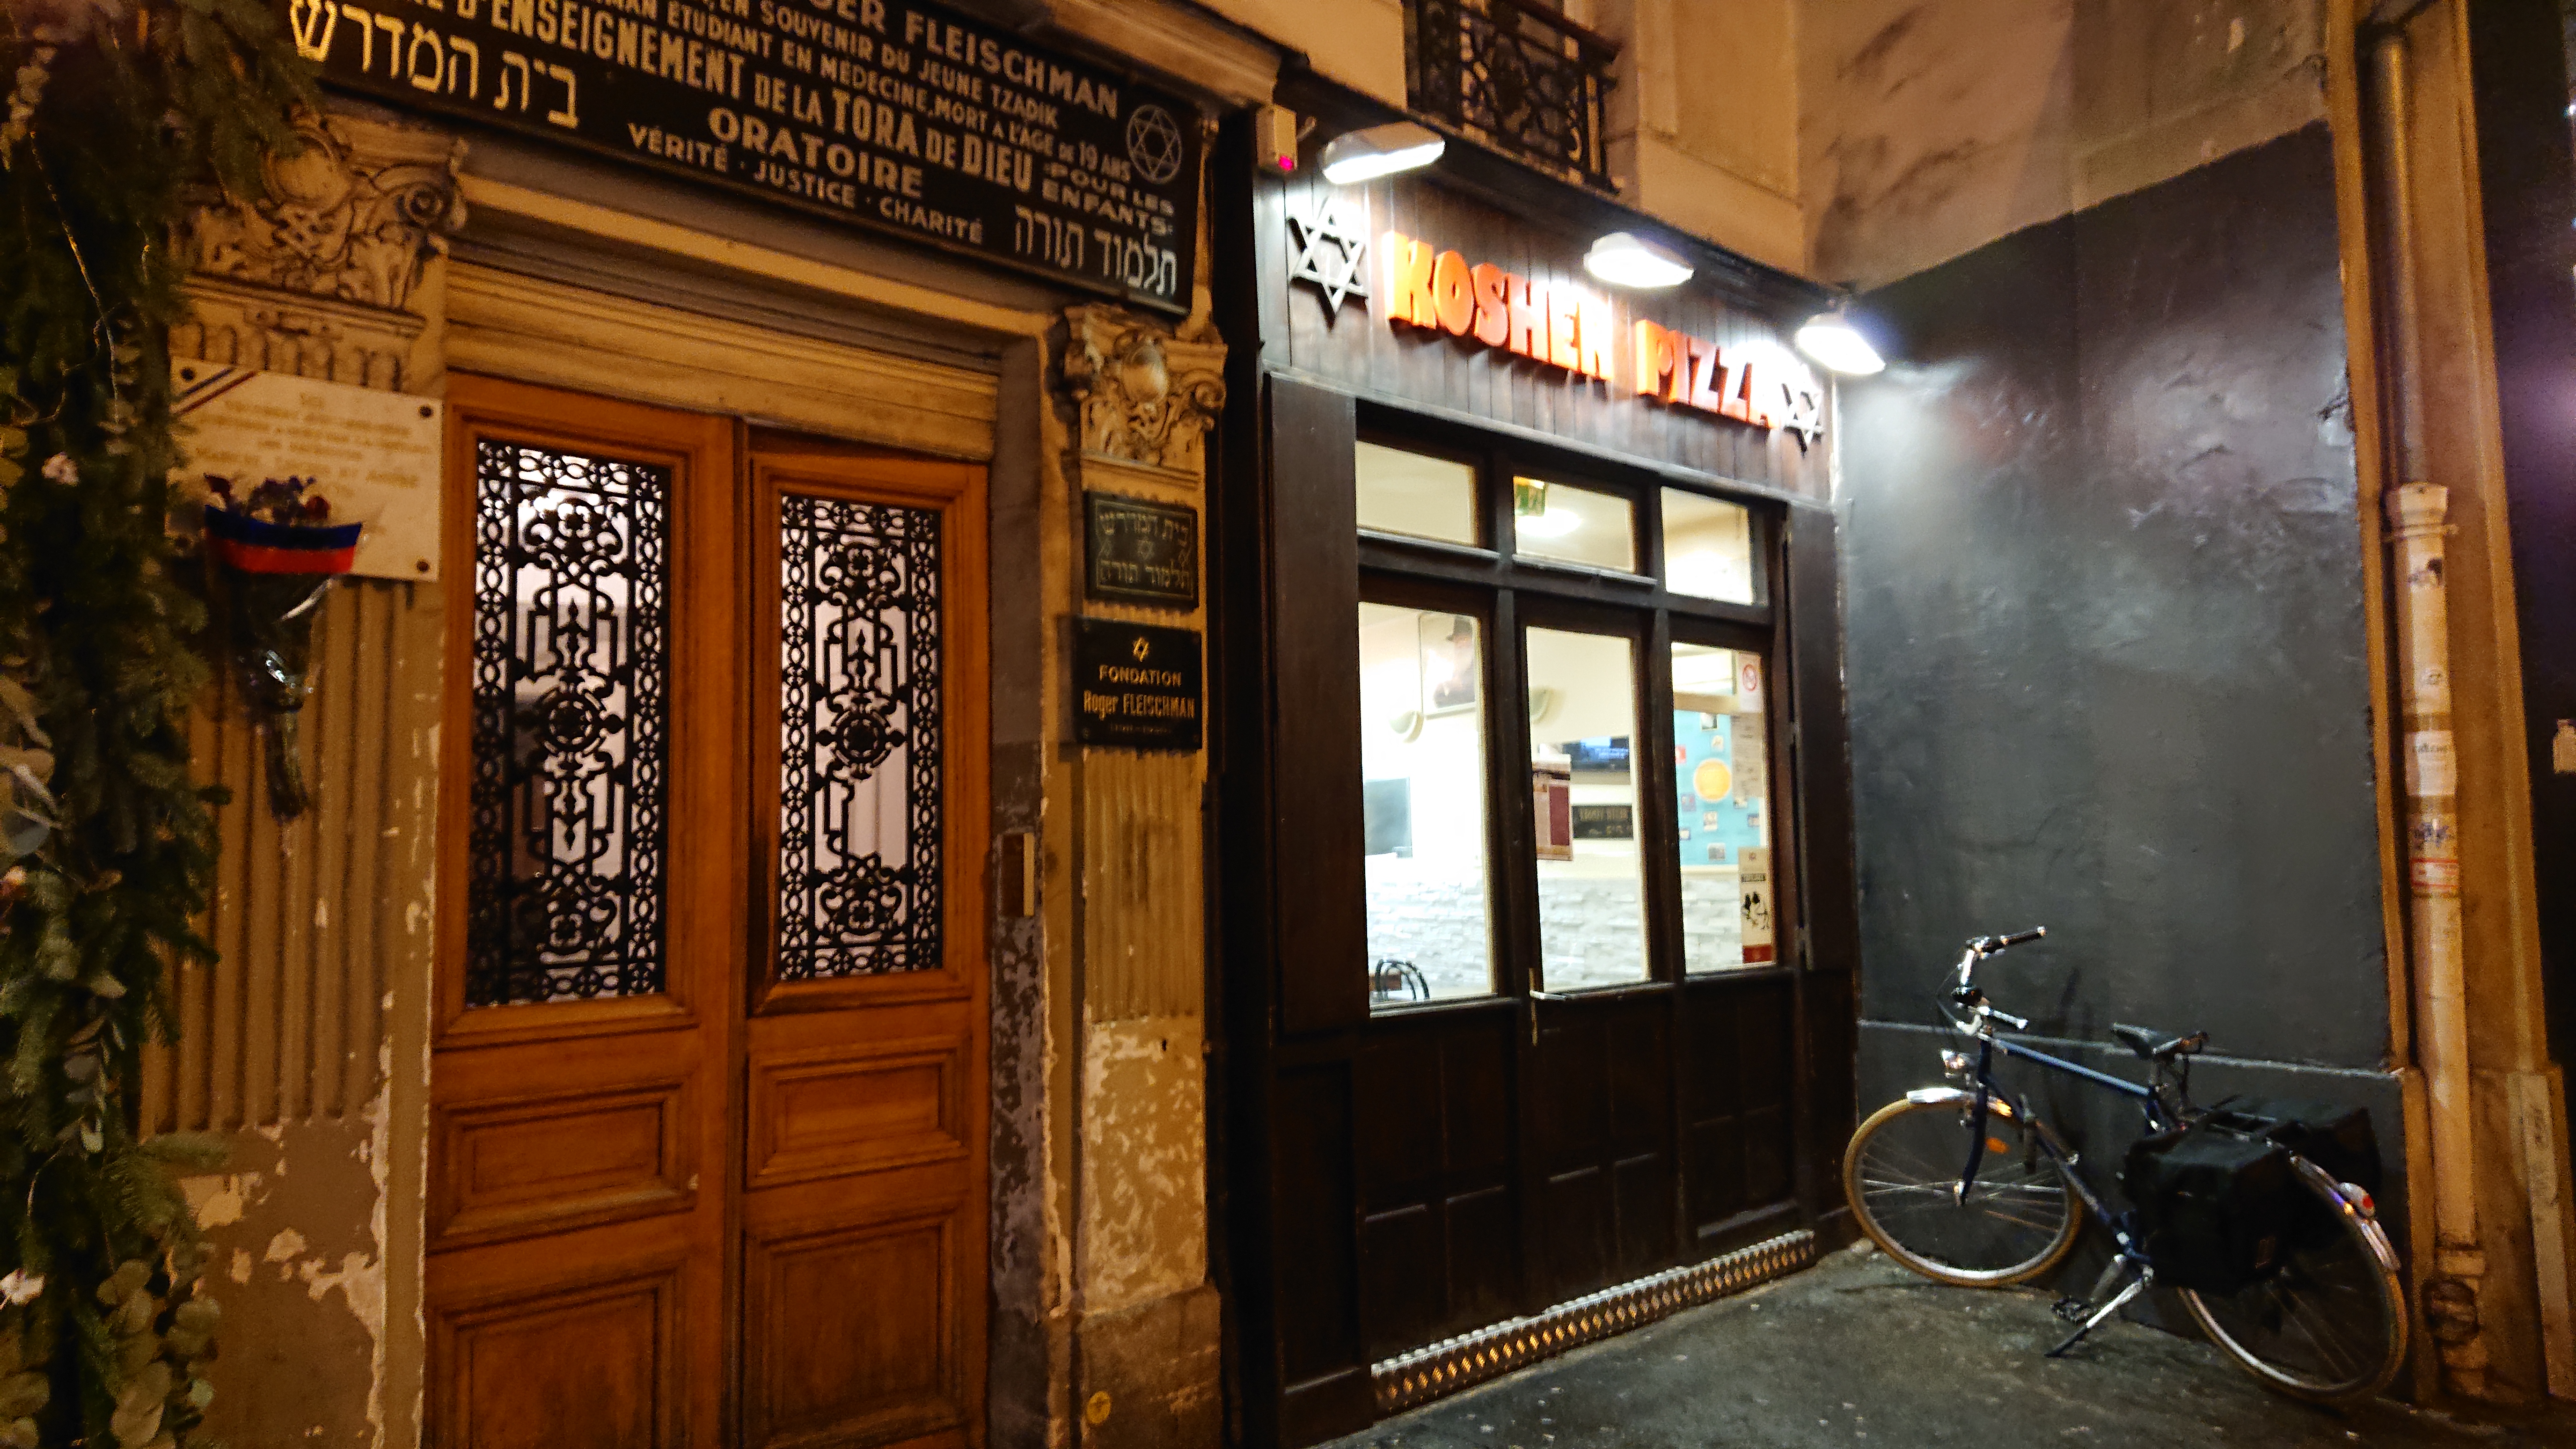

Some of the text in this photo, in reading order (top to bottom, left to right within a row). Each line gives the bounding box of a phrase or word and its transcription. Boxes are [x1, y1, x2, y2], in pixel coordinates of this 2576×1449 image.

[290, 0, 580, 130] בית המדרש
[760, 0, 874, 61] SOUVENIR
[881, 43, 911, 74] DU
[918, 59, 983, 102] JEUNE
[990, 83, 1059, 130] TZADIK
[782, 38, 812, 74] EN
[1079, 140, 1098, 172] 19
[1100, 153, 1131, 183] ANS
[905, 9, 1118, 120] FLEISCHMAN
[707, 106, 923, 199] ORATOIRE
[754, 72, 787, 115] DE
[792, 84, 824, 127] LA
[832, 87, 919, 157] TORA
[925, 127, 958, 170] DE
[961, 132, 1033, 194] DIEU
[753, 159, 856, 209] JUSTICE
[879, 196, 983, 245] CHARITÉ
[1043, 162, 1175, 217] POUR LES
[1015, 204, 1178, 297] תלמוד תורה
[1382, 230, 1614, 382] KOSHER
[1083, 689, 1195, 721] Roger FLEISCHMAN
[1099, 664, 1182, 688] FONDATION
